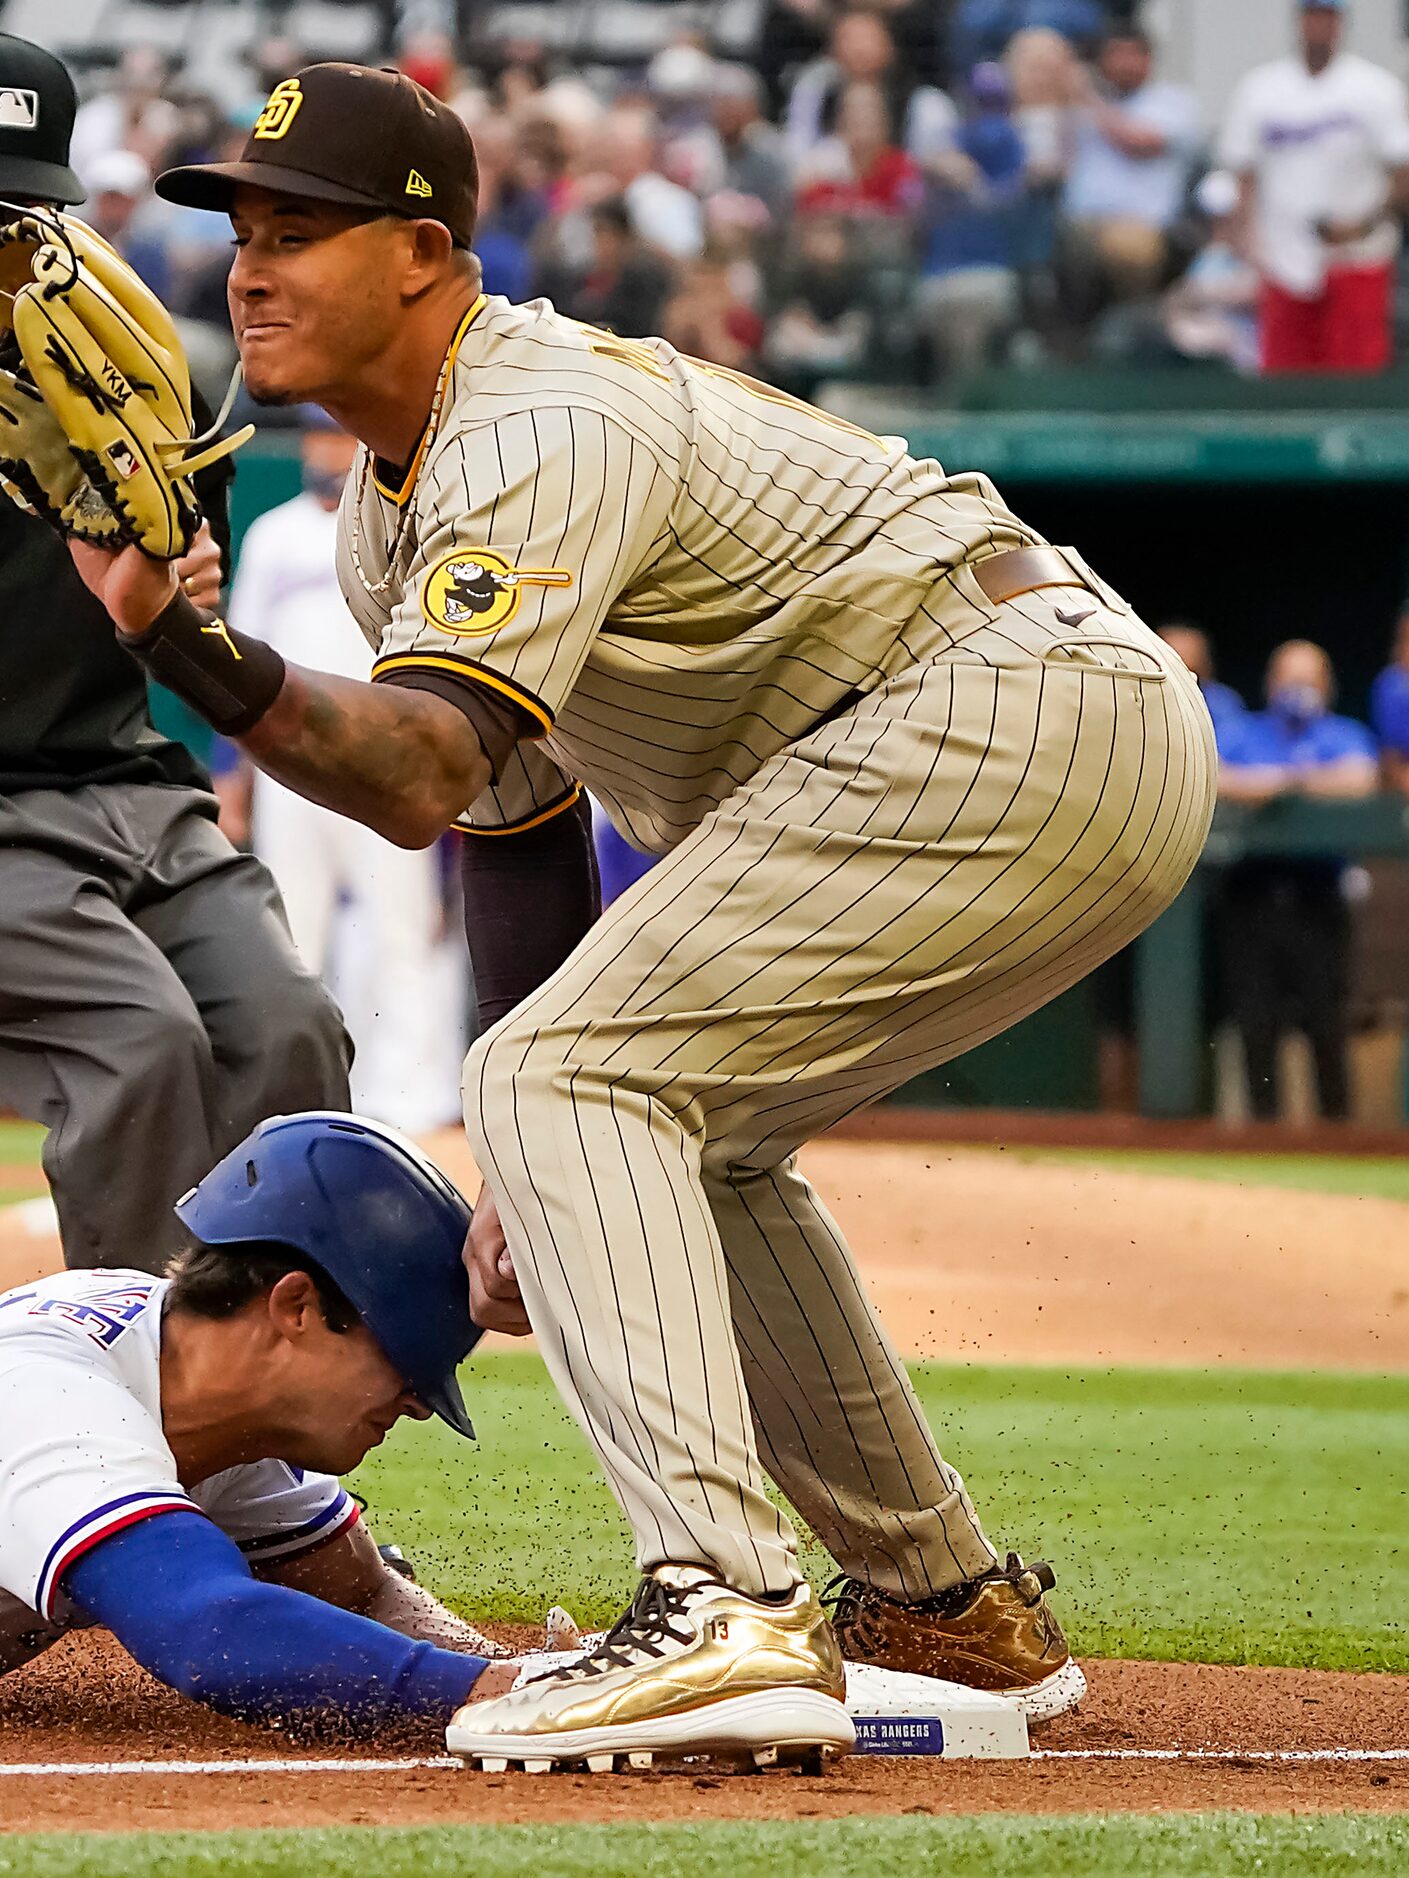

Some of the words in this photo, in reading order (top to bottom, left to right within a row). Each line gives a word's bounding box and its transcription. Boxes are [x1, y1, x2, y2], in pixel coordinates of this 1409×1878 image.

[254, 78, 303, 140] SD
[102, 358, 132, 402] YKM
[705, 1619, 729, 1640] 13
[855, 1724, 878, 1739] XAS
[881, 1724, 930, 1738] RANGERS
